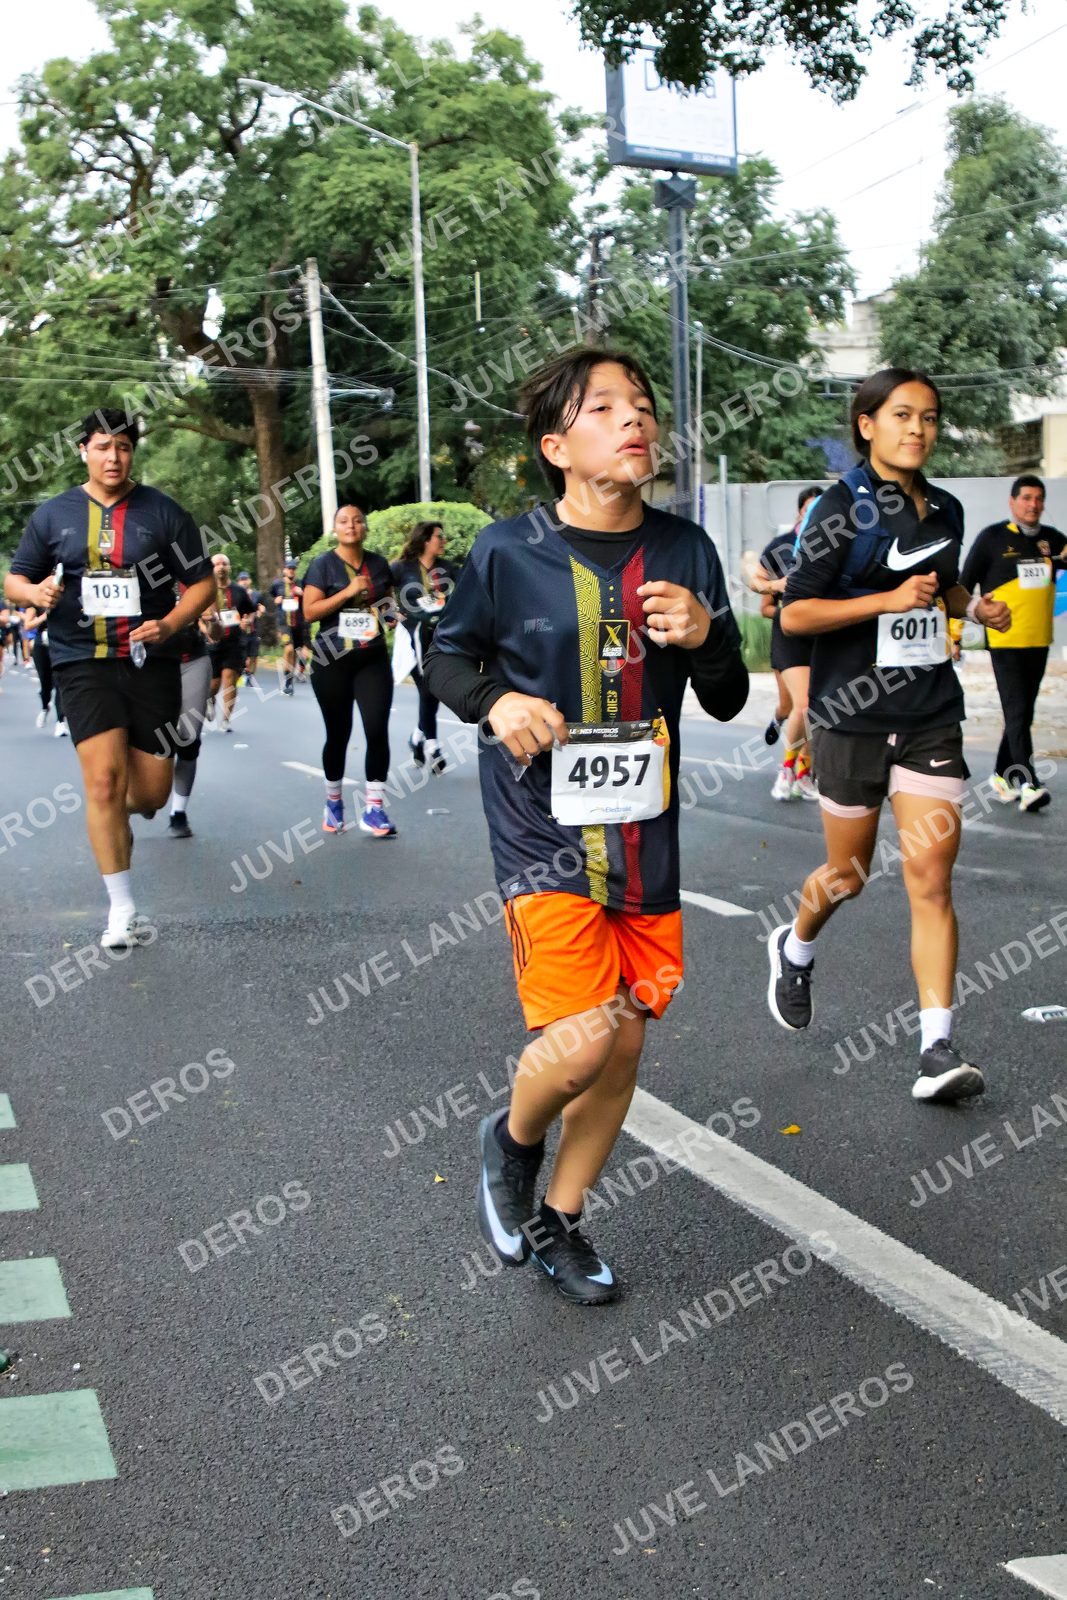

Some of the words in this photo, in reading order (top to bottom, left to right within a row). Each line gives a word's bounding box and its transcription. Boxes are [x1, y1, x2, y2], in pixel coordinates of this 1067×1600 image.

[93, 584, 129, 599] 1031
[345, 617, 370, 628] 6895
[891, 616, 937, 640] 6011
[568, 754, 651, 789] 4957
